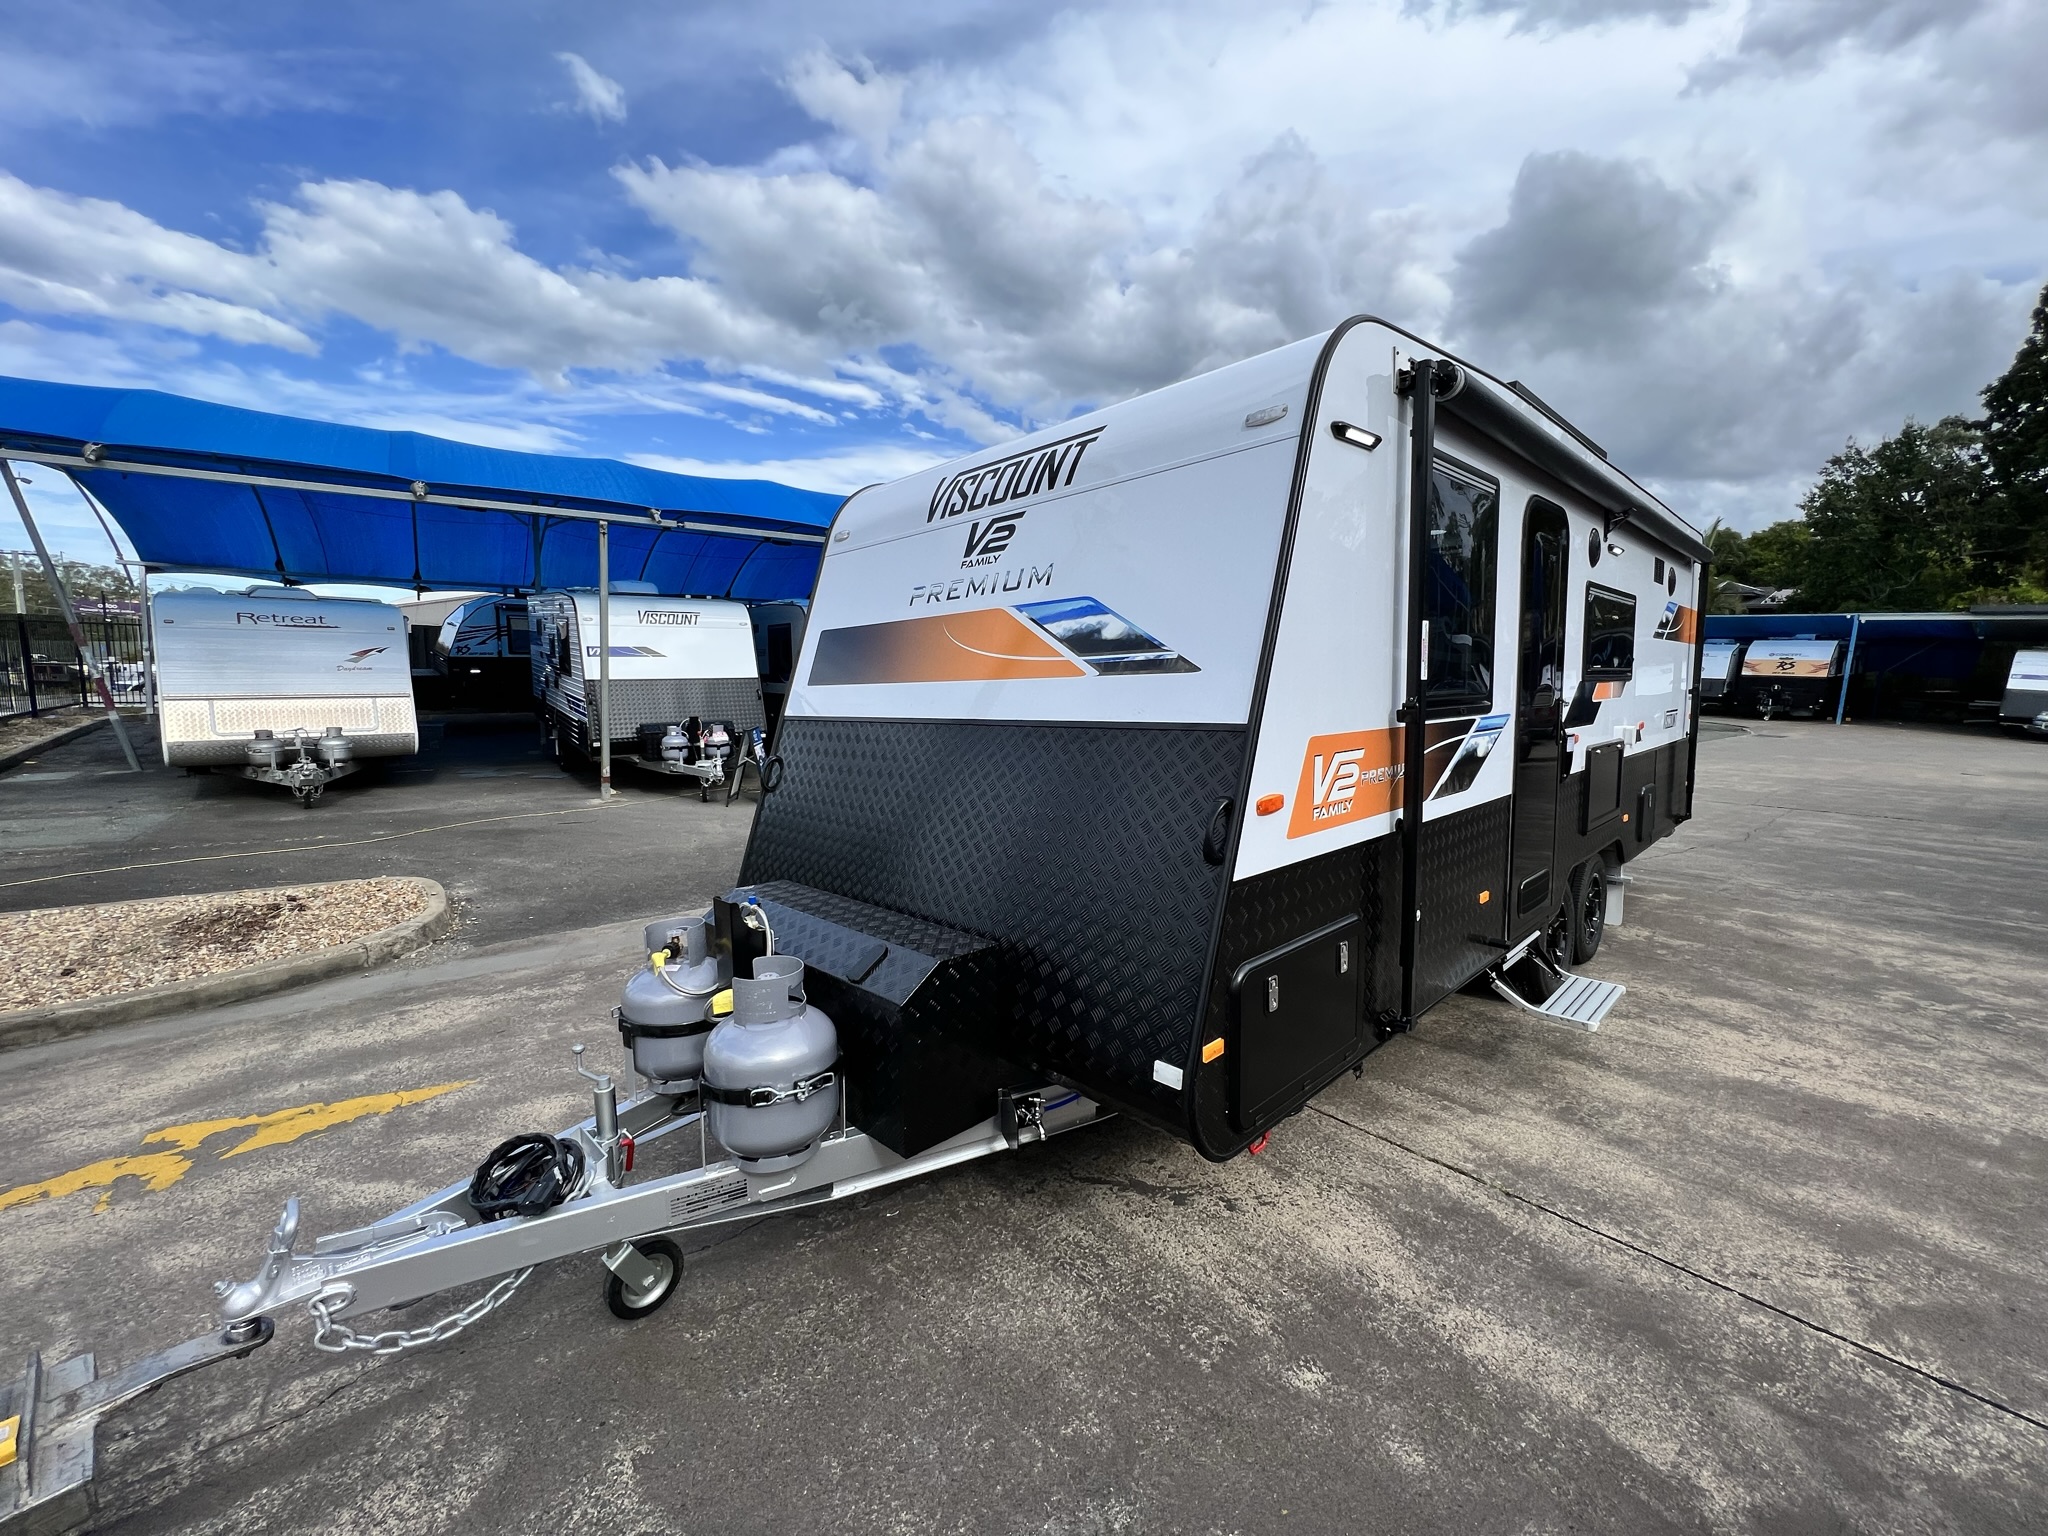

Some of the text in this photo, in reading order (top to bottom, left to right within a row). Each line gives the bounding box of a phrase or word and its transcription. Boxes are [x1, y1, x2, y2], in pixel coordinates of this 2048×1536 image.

[926, 424, 1108, 523] VISCOUNT
[964, 510, 1027, 558] V2
[960, 553, 1002, 570] FAMILY
[909, 562, 1054, 607] PREMIUM
[236, 612, 328, 625] Retreat
[637, 610, 701, 626] VISCOUNT
[1312, 748, 1365, 805] V2
[1360, 762, 1405, 788] PREMIU
[1312, 799, 1353, 822] FAMILY
